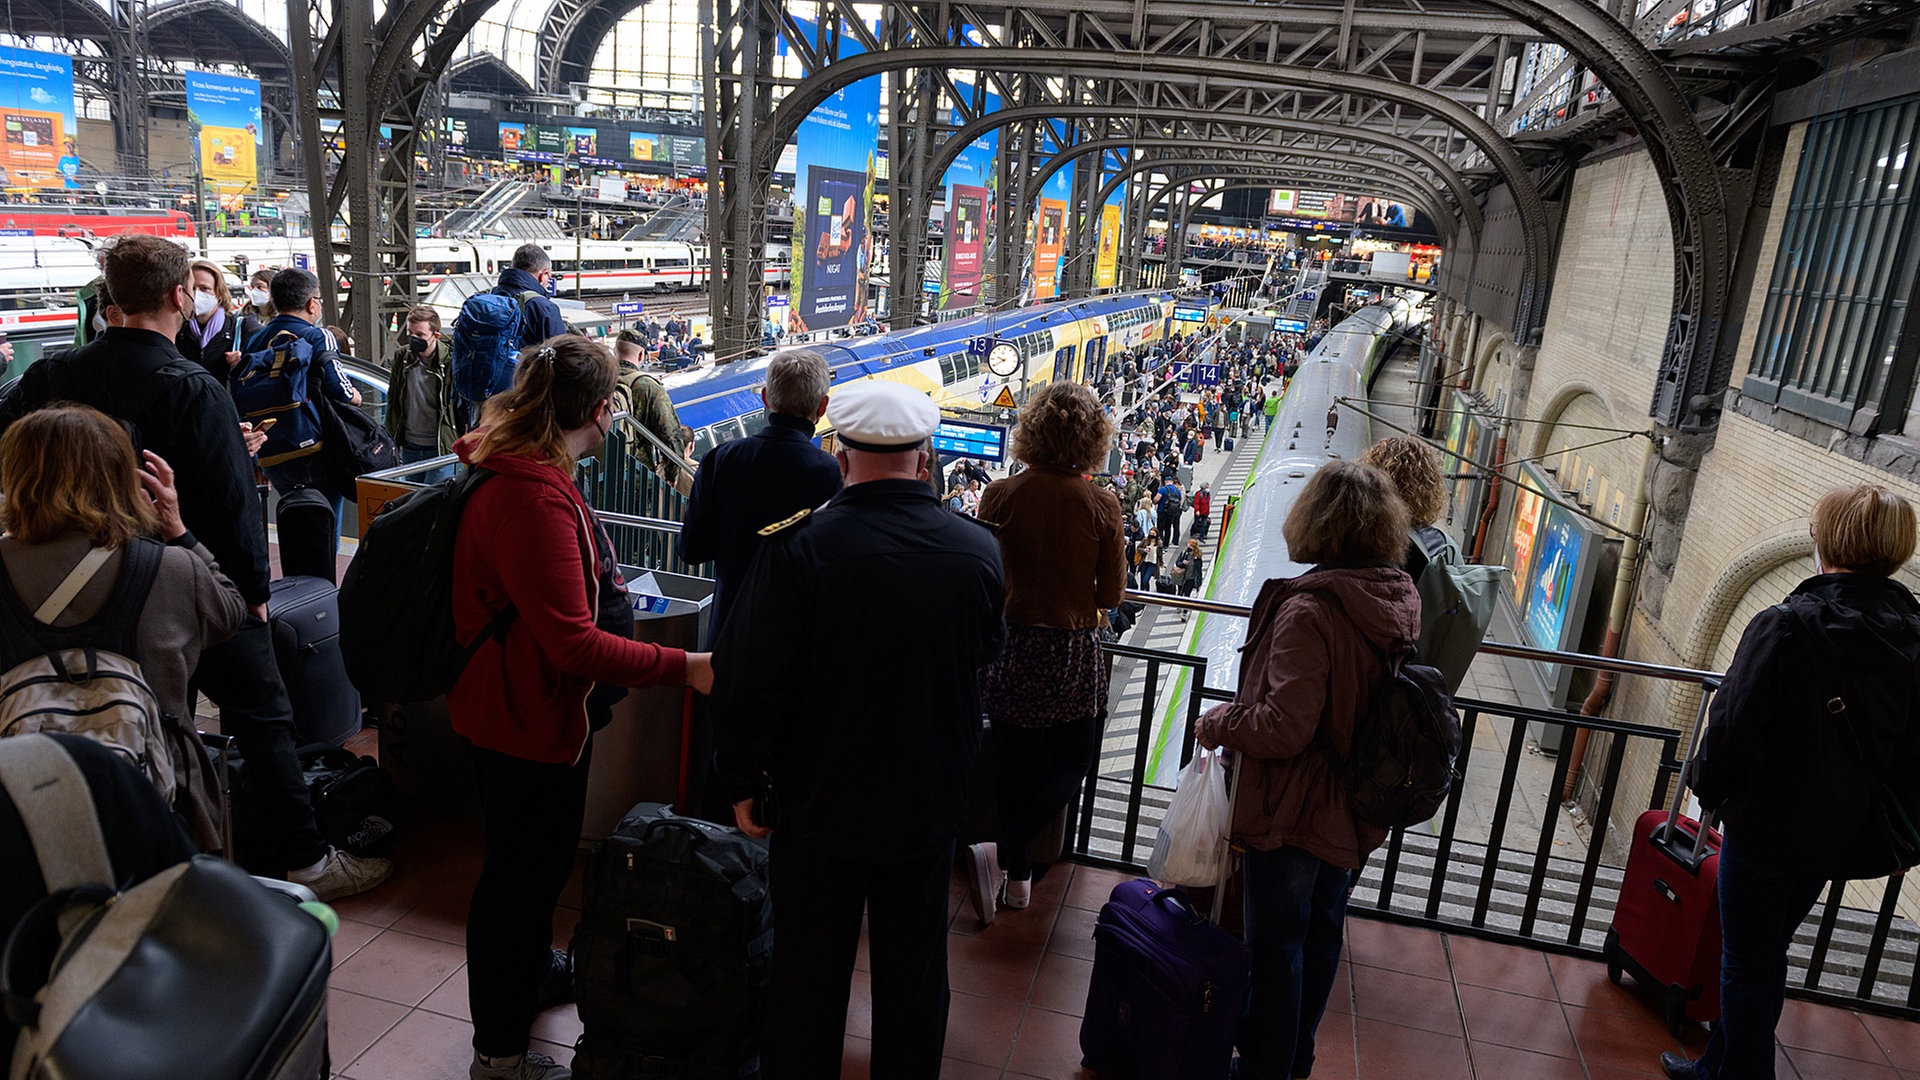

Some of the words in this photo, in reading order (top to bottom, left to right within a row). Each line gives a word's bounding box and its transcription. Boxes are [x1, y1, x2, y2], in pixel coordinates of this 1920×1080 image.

[294, 254, 303, 268] E
[972, 338, 986, 353] 13
[1200, 366, 1216, 381] 14
